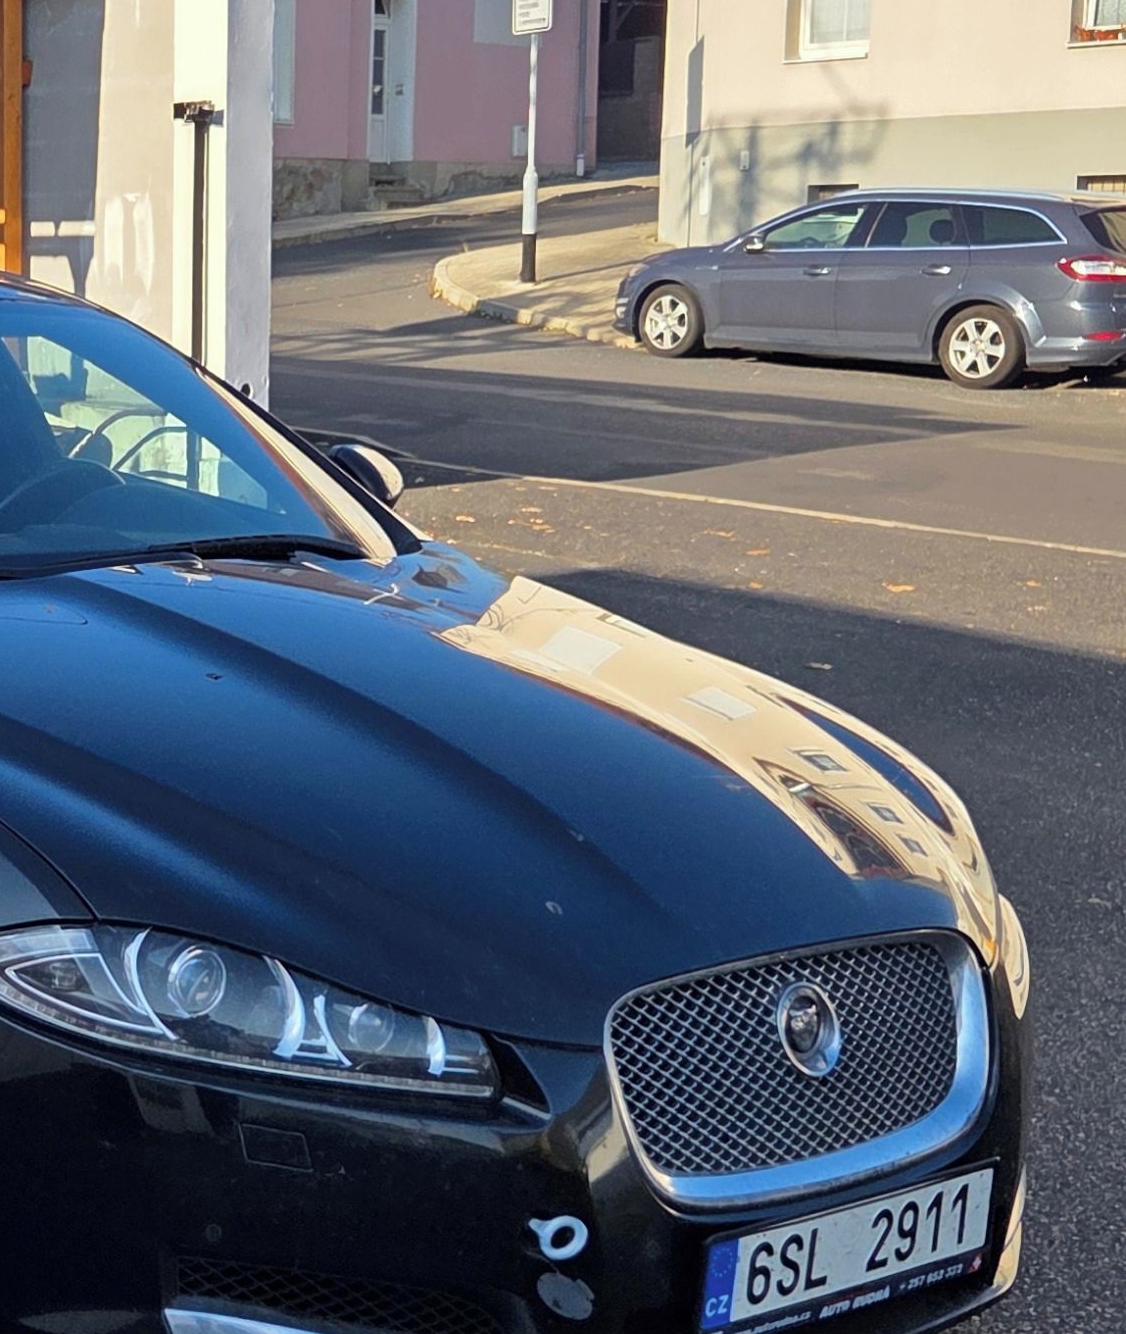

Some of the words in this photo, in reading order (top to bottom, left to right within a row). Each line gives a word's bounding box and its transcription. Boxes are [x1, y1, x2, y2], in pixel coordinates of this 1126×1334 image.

[747, 1228, 827, 1305] 6SL
[865, 1183, 970, 1272] 2911
[705, 1295, 728, 1317] CZ
[819, 1299, 851, 1319] AUTO
